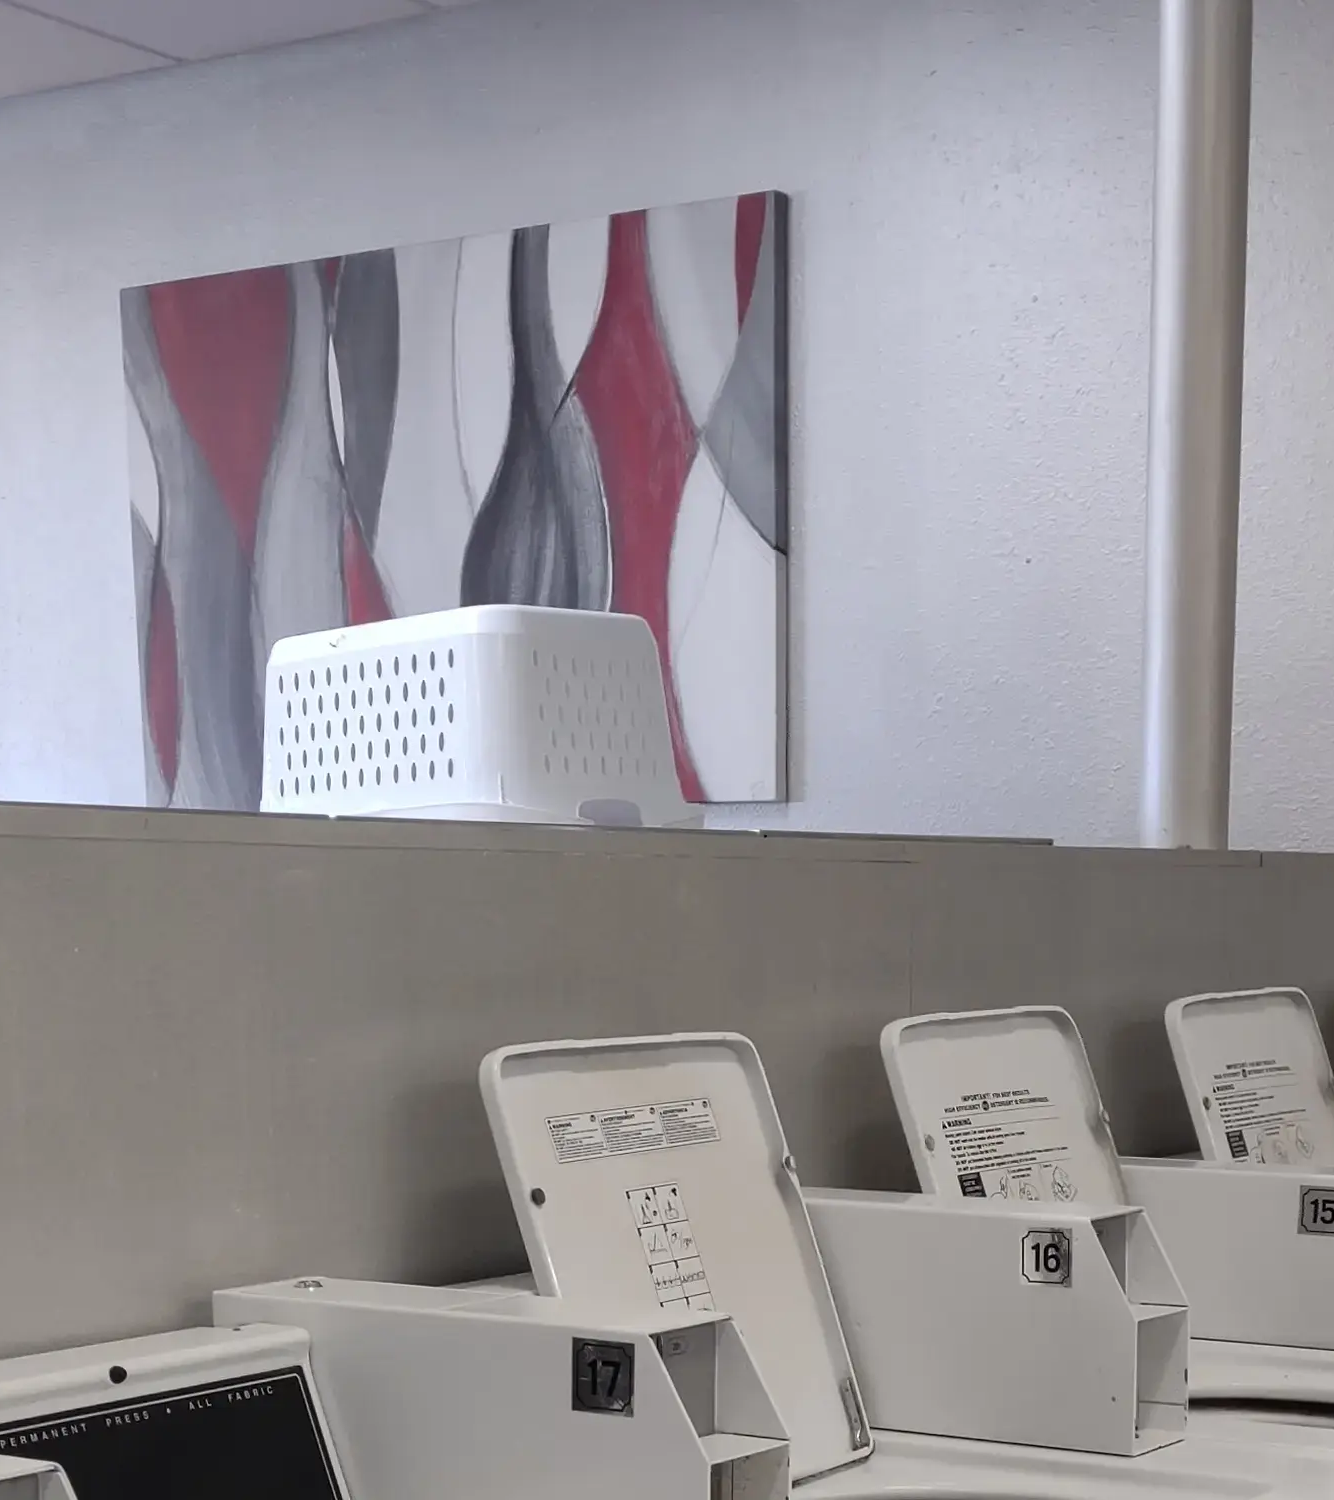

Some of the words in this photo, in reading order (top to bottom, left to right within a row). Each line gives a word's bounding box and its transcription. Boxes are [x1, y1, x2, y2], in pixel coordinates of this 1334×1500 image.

[1031, 1243, 1061, 1272] 16
[587, 1359, 621, 1396] 17
[0, 1423, 87, 1449] PERMANENT
[105, 1410, 149, 1427] PRESS
[189, 1398, 213, 1412] ALL
[227, 1386, 273, 1403] FABRIC
